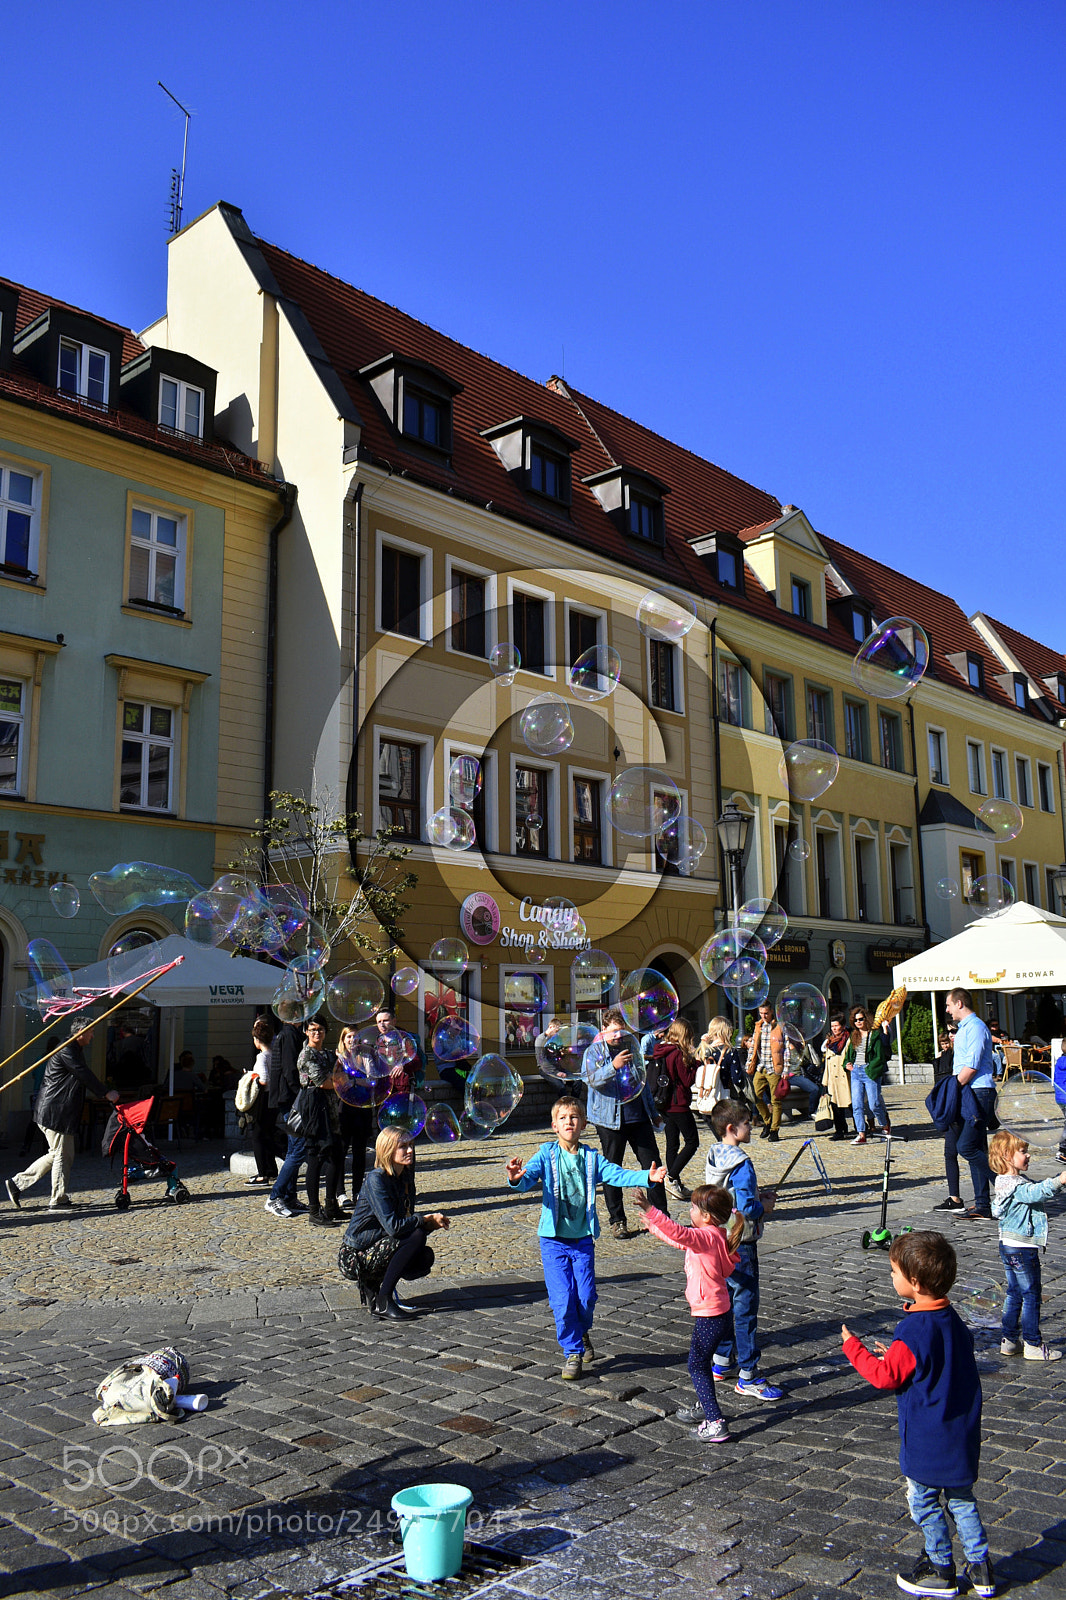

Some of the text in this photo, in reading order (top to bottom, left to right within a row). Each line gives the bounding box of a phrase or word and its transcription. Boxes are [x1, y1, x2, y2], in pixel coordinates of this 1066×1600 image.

[519, 896, 575, 932] Candy
[500, 926, 593, 954] Shop & Shows
[784, 945, 806, 954] BROWAR
[902, 975, 961, 983] RESTAURACJA
[1016, 970, 1055, 978] BROWAR
[209, 985, 245, 996] VEGA
